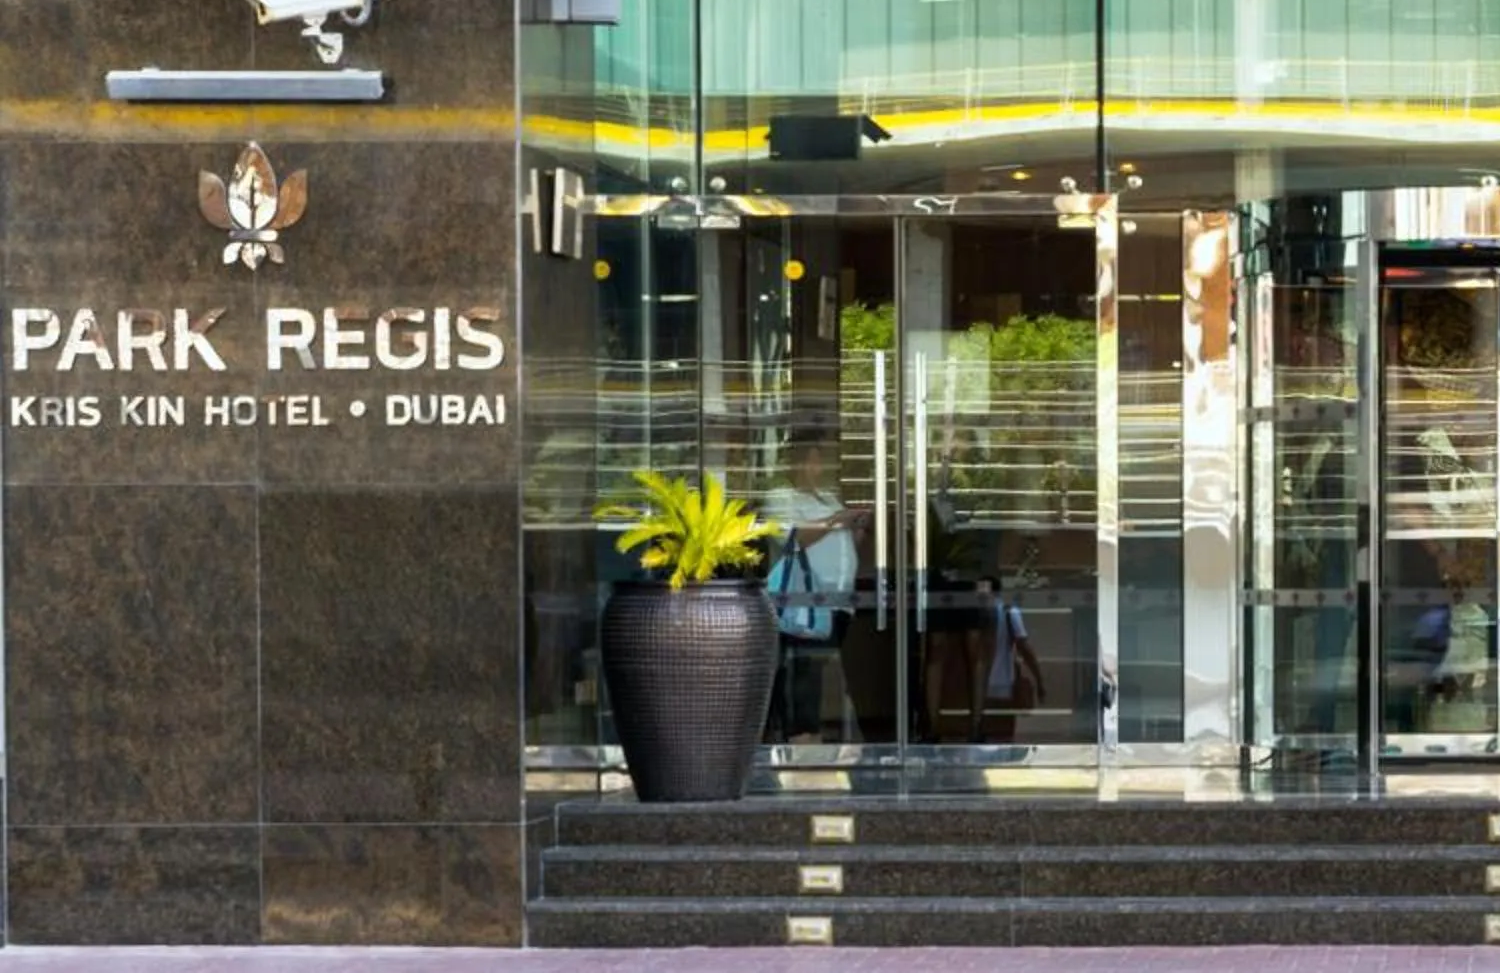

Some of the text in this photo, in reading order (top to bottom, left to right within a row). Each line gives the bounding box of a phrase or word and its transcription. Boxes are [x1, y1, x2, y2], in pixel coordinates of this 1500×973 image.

[11, 306, 506, 371] PARK REGIS
[10, 394, 506, 427] KRIS KIN HOTEL DUBAI
